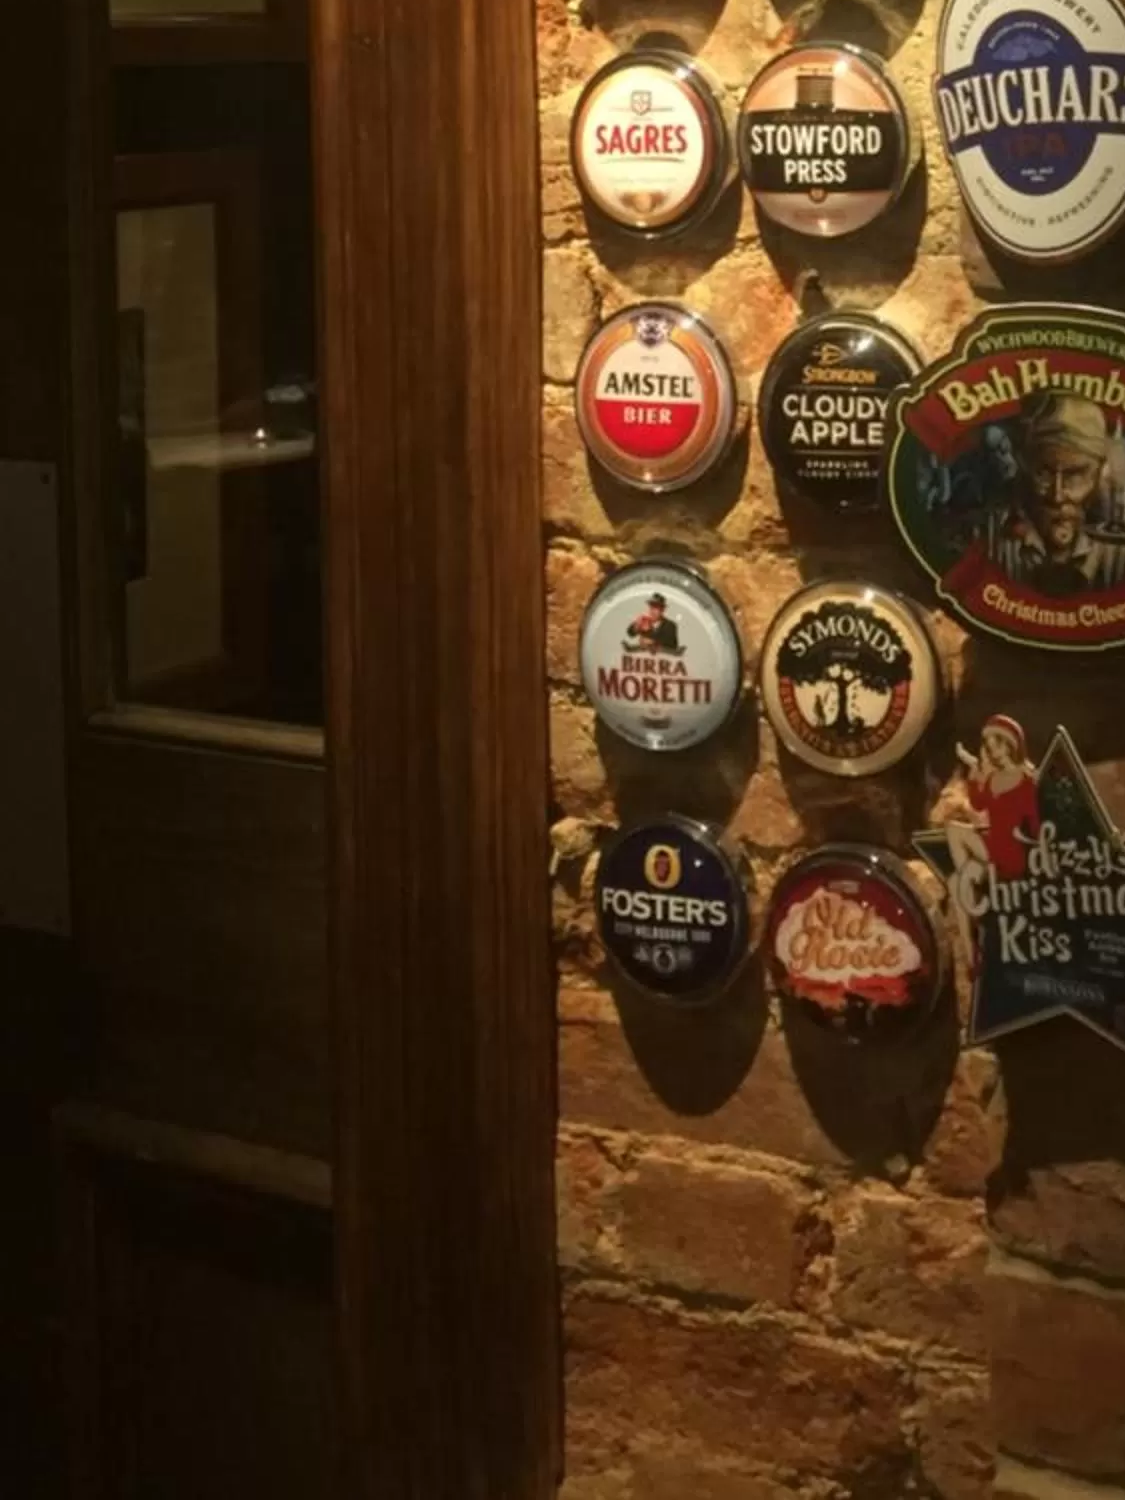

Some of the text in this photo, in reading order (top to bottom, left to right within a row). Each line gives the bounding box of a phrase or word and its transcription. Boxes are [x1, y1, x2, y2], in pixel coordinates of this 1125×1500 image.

[595, 124, 688, 155] SAGRES
[750, 124, 882, 156] STOWFORD
[784, 158, 847, 184] PRESS
[604, 370, 694, 398] AMSTEL
[940, 368, 1019, 421] Bah
[623, 406, 672, 426] BIER
[783, 395, 888, 420] CLOUDY
[790, 422, 885, 446] APPLE
[982, 584, 1077, 627] Christmas
[788, 615, 899, 663] SYMONDS
[621, 655, 688, 677] BIRRA
[598, 667, 712, 704] MORETTI
[602, 887, 728, 927] FOSTER'S
[998, 914, 1073, 965] Kiss
